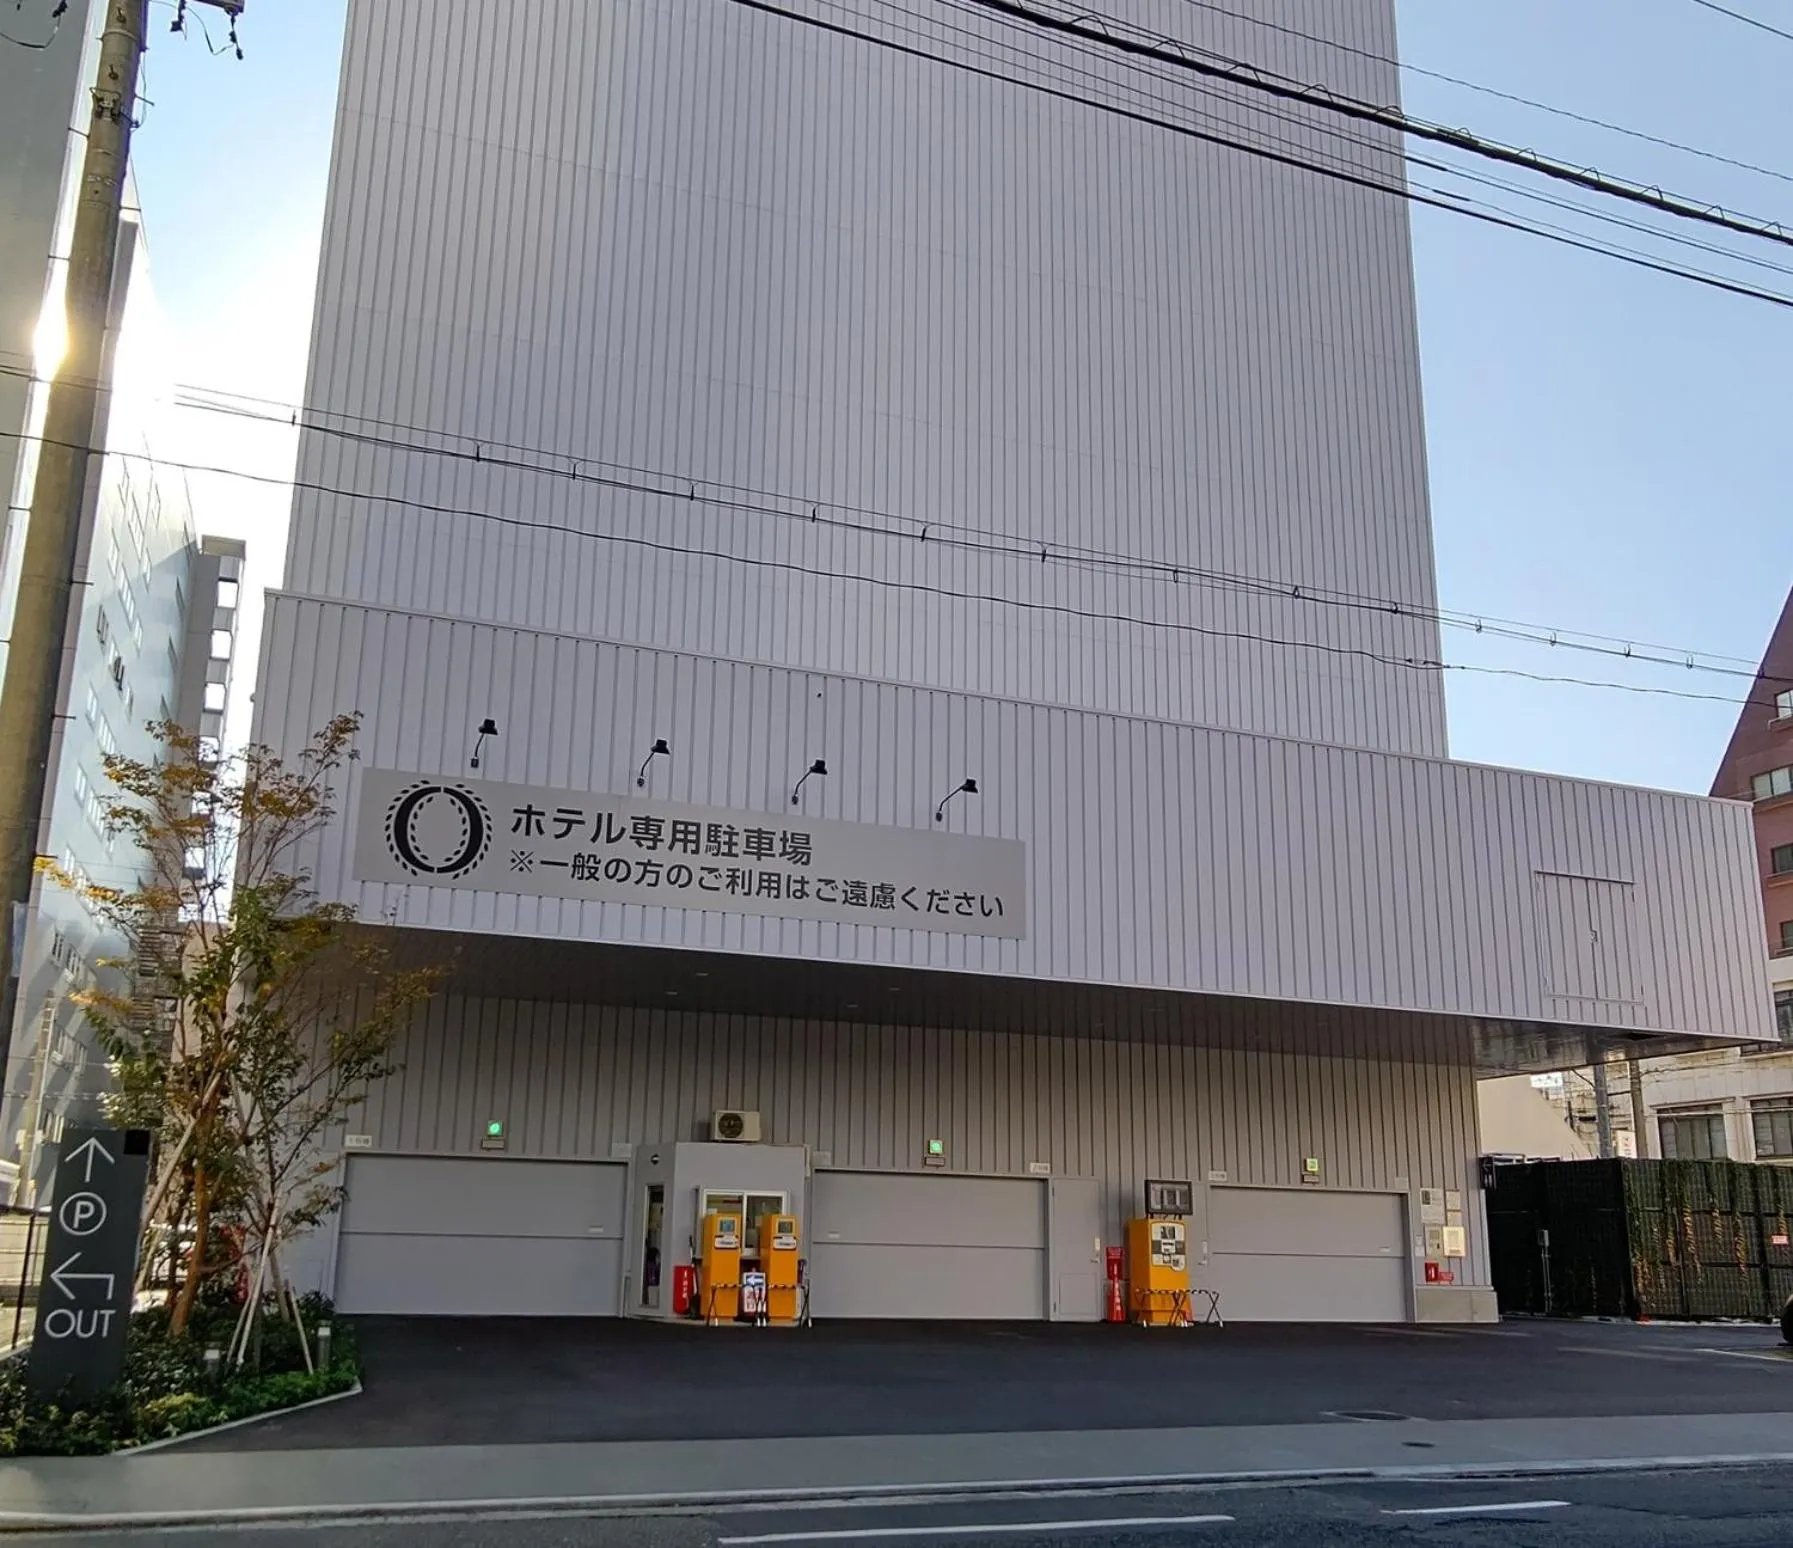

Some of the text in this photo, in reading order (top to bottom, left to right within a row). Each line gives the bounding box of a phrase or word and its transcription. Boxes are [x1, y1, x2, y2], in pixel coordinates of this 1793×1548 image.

[511, 804, 813, 866] ホテル専用駐車場
[510, 849, 1004, 918] ※一般の方のご利用はご遠慮ください
[73, 1200, 96, 1229] P
[44, 1308, 117, 1339] OUT
